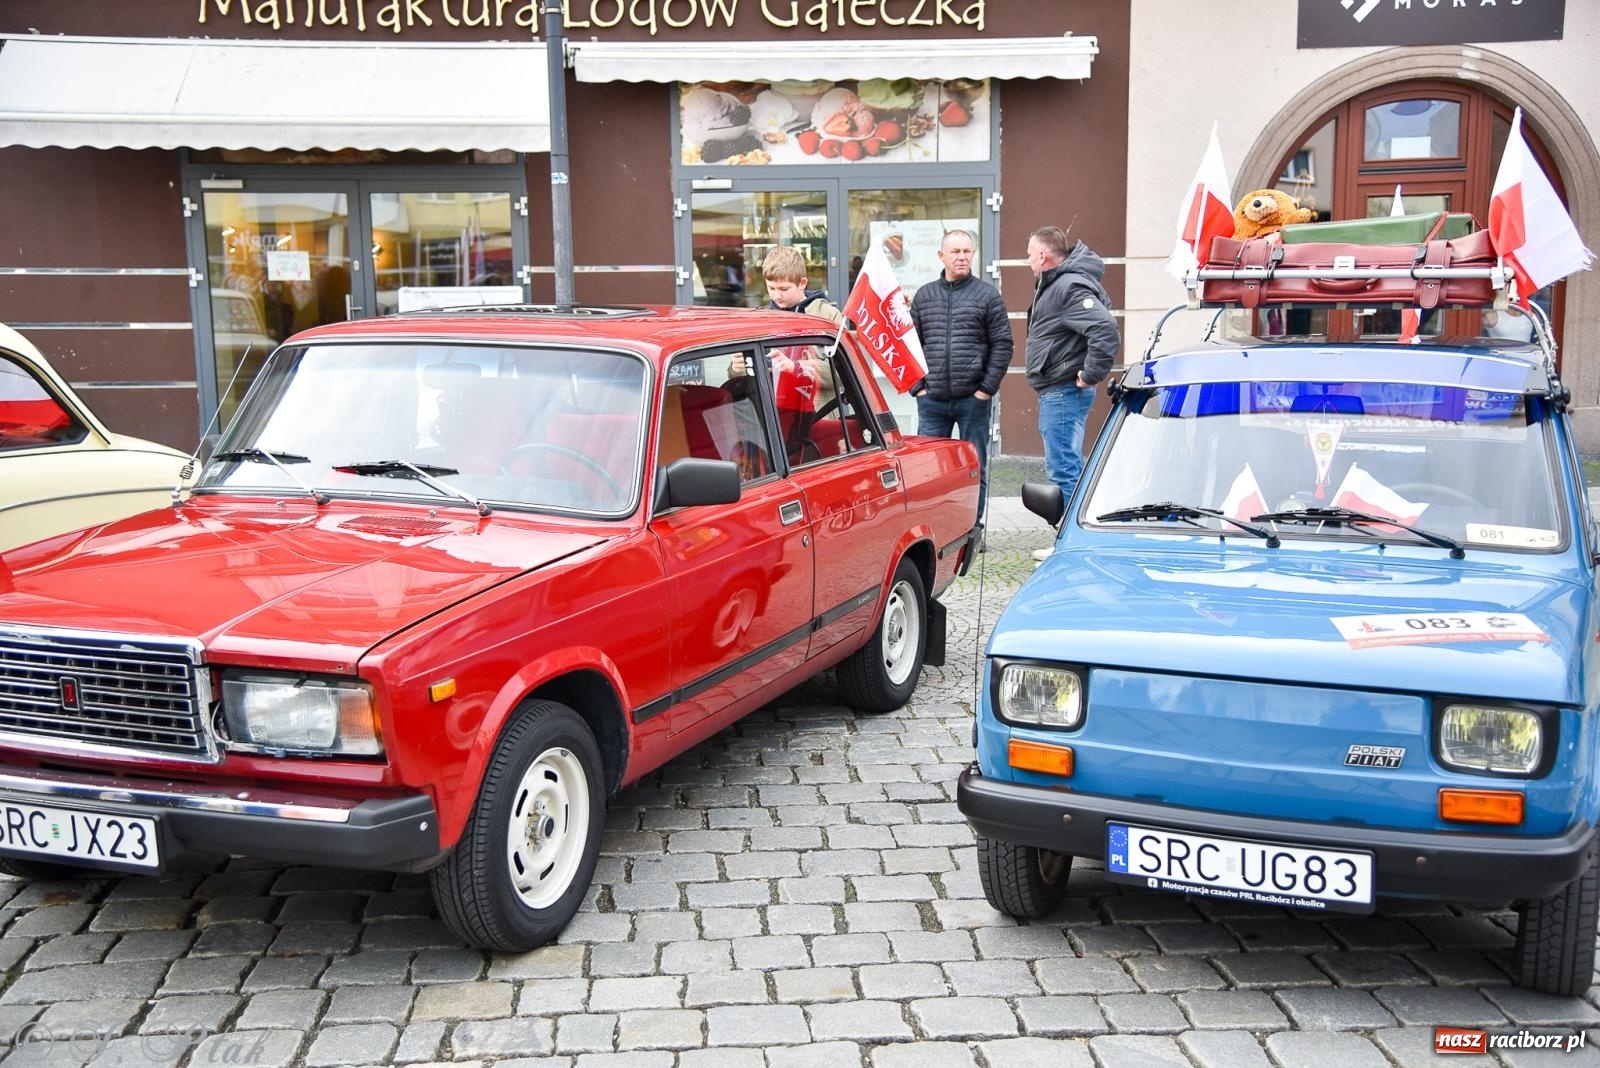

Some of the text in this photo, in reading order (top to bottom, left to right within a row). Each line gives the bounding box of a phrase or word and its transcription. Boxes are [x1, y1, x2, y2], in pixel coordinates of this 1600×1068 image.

[1480, 529, 1505, 540] 081
[1405, 617, 1472, 630] 083
[1351, 746, 1402, 756] POLSKI
[1348, 754, 1399, 767] FIAT
[0, 807, 148, 860] RC JX23
[1111, 854, 1126, 867] PL
[1138, 835, 1357, 897] SRC UG83
[1162, 881, 1209, 895] Motoryzacja
[1210, 889, 1238, 898] czasów
[1239, 891, 1254, 900] PRL
[1255, 893, 1290, 904] Racibórz
[1296, 898, 1326, 909] okolice
